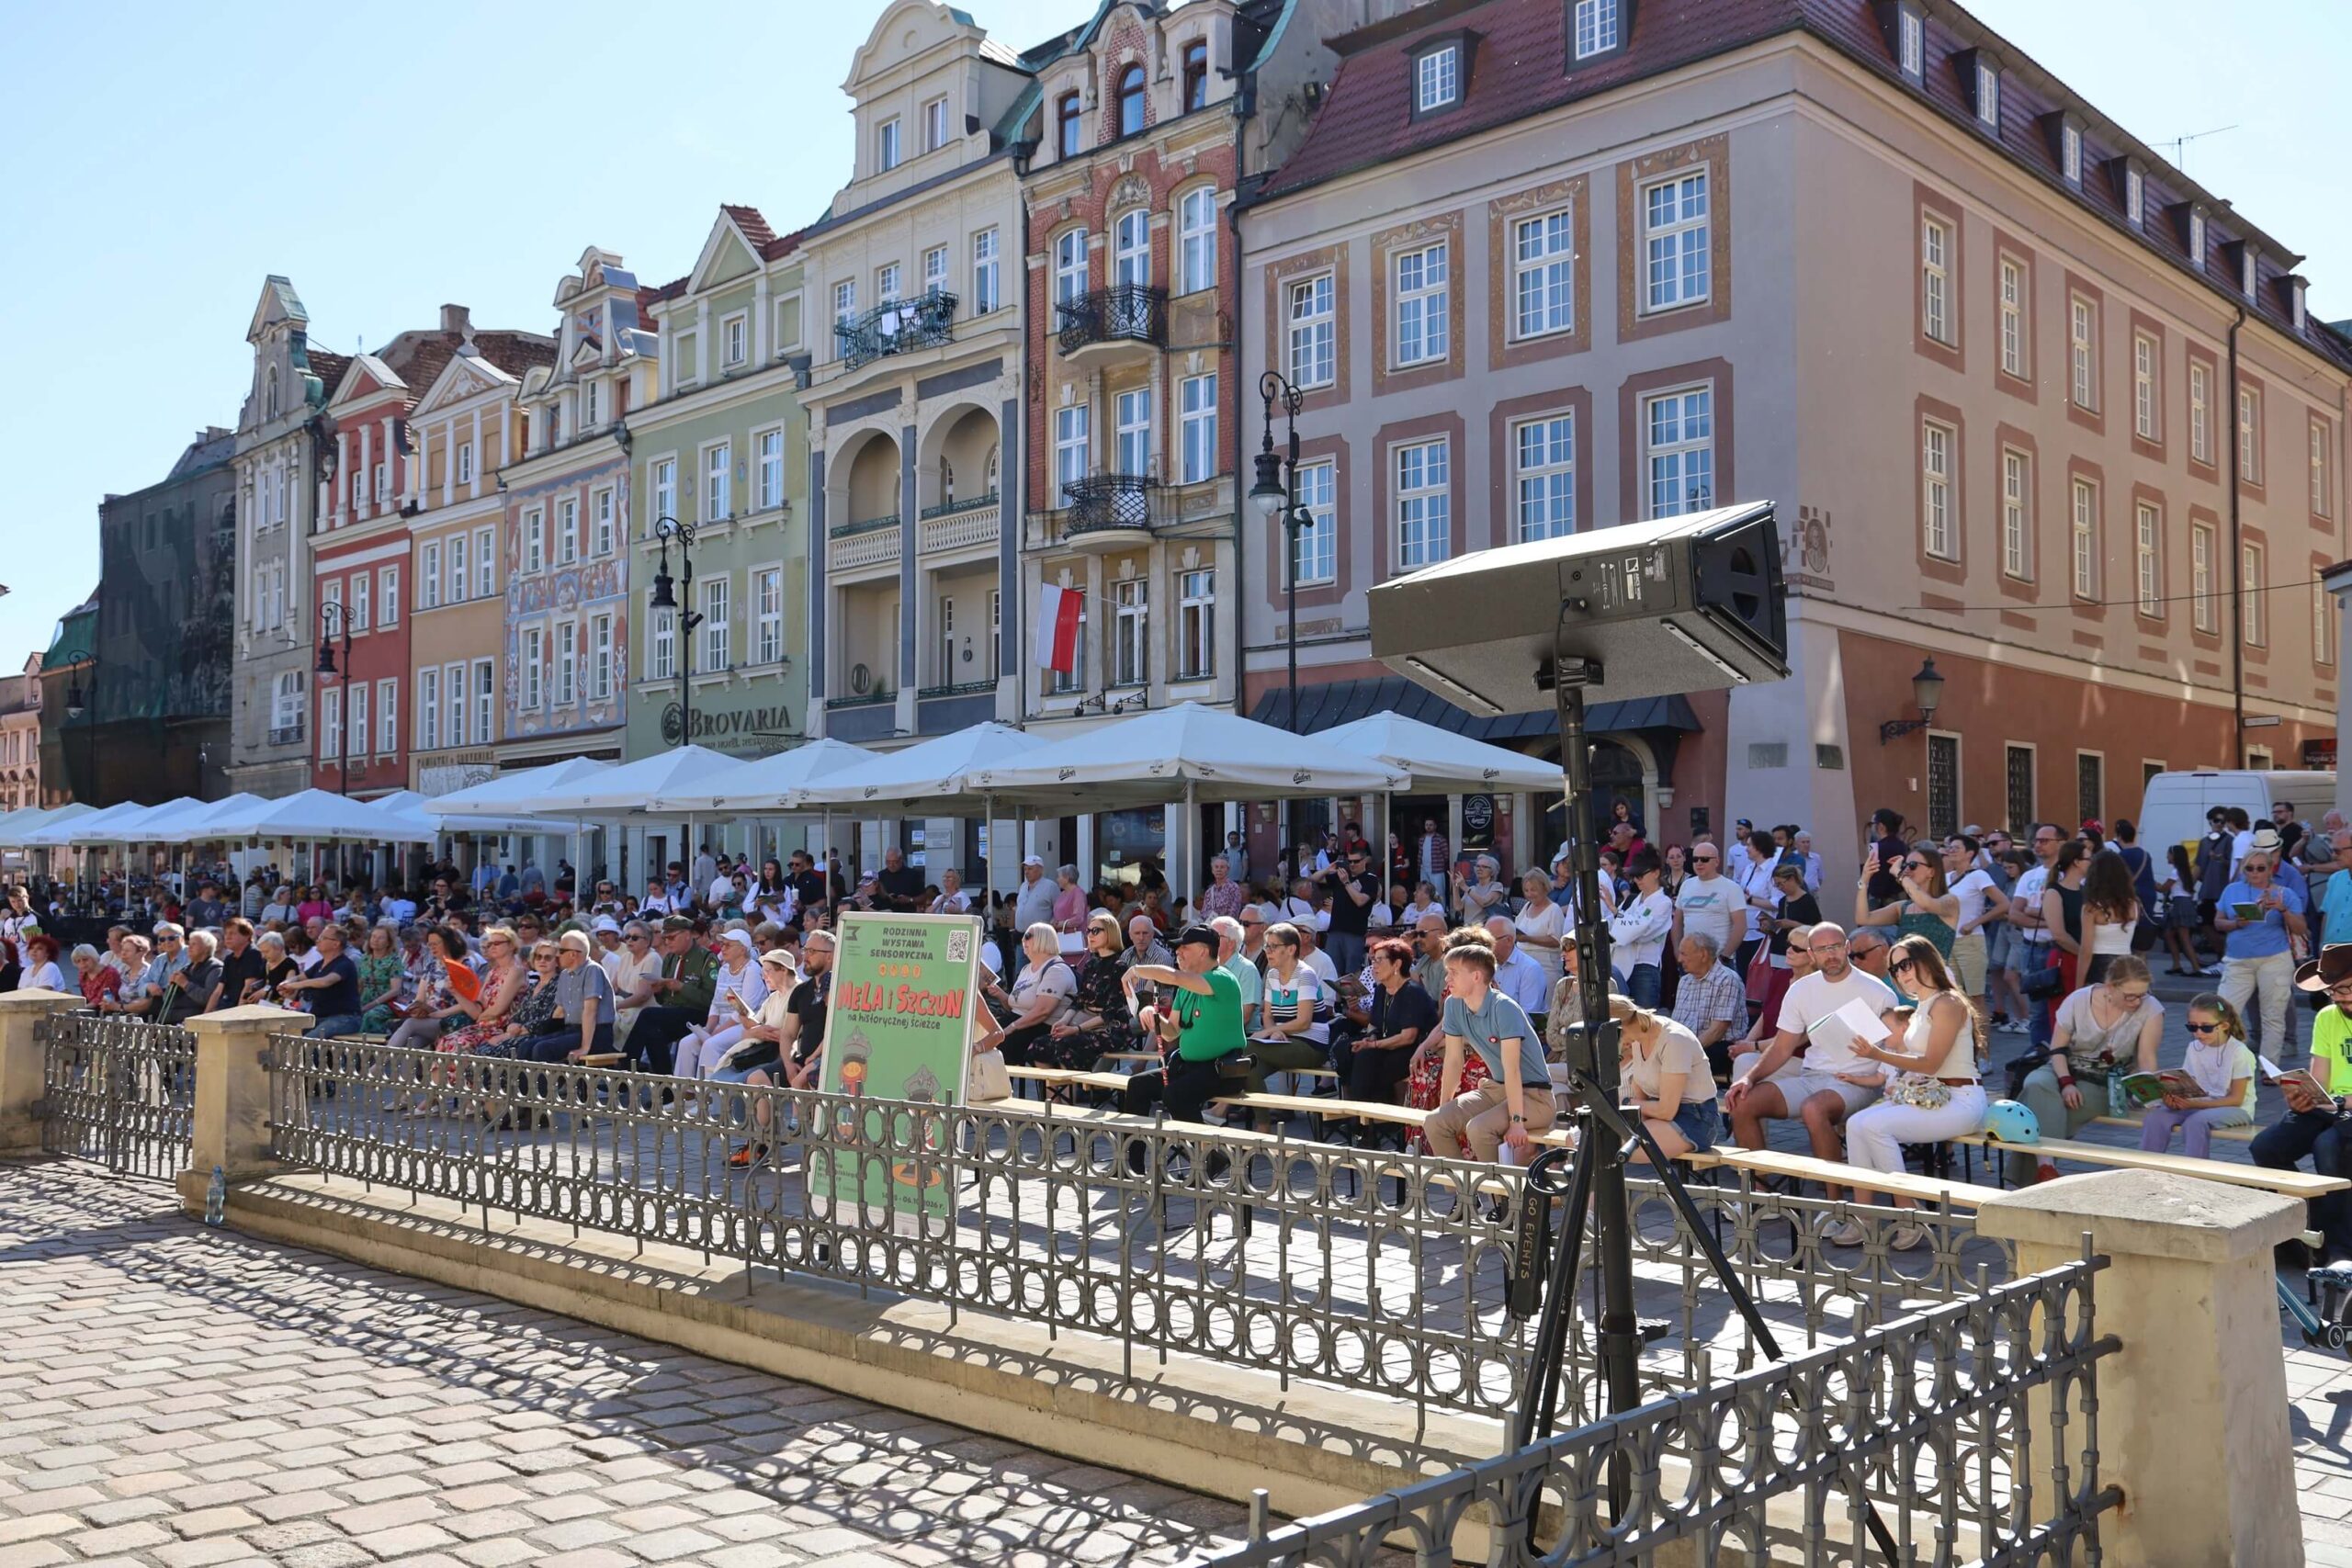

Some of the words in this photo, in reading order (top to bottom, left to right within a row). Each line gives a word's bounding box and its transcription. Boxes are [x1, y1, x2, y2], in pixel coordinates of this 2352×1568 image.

[689, 705, 792, 737] BROVARIA
[883, 927, 927, 937] RODZINNA
[882, 939, 924, 948] WYSTAWA
[870, 949, 933, 960] SENSORYCZNA
[888, 989, 893, 1010] i
[858, 1012, 909, 1029] historycznej
[910, 1015, 941, 1030] ścieżce
[1528, 1198, 1538, 1216] GO
[1521, 1223, 1535, 1280] EVENTS
